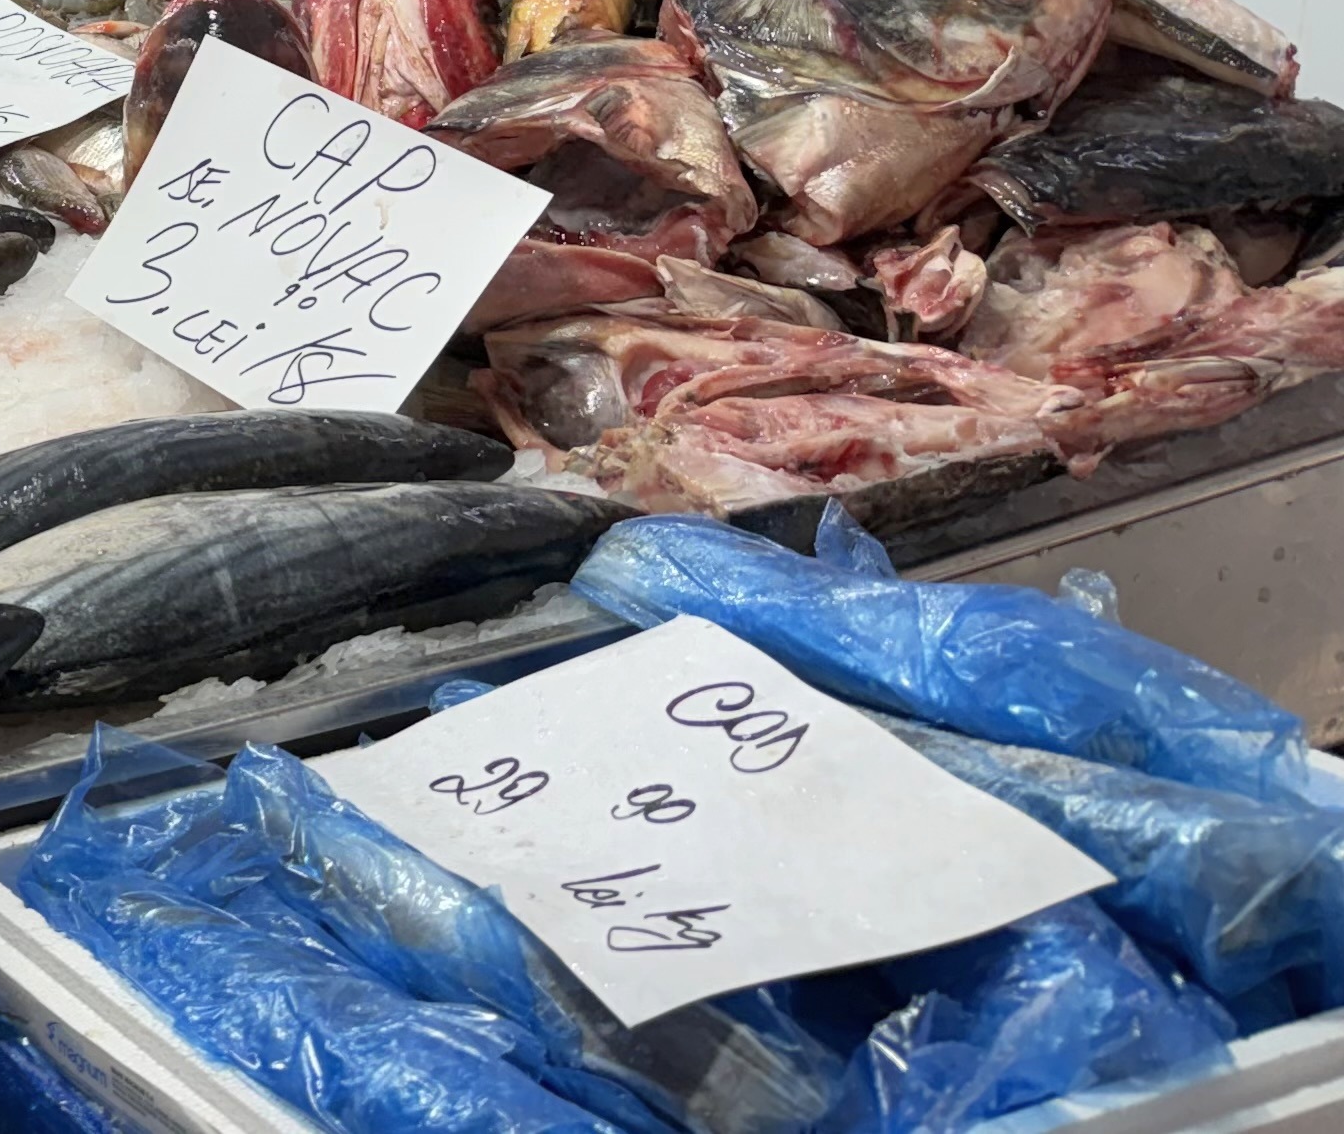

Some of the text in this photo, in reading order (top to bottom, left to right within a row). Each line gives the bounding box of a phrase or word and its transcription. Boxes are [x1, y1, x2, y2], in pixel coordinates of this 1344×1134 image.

[263, 92, 437, 216] CAP
[217, 194, 442, 332] NOVAC
[611, 783, 696, 824] 90
